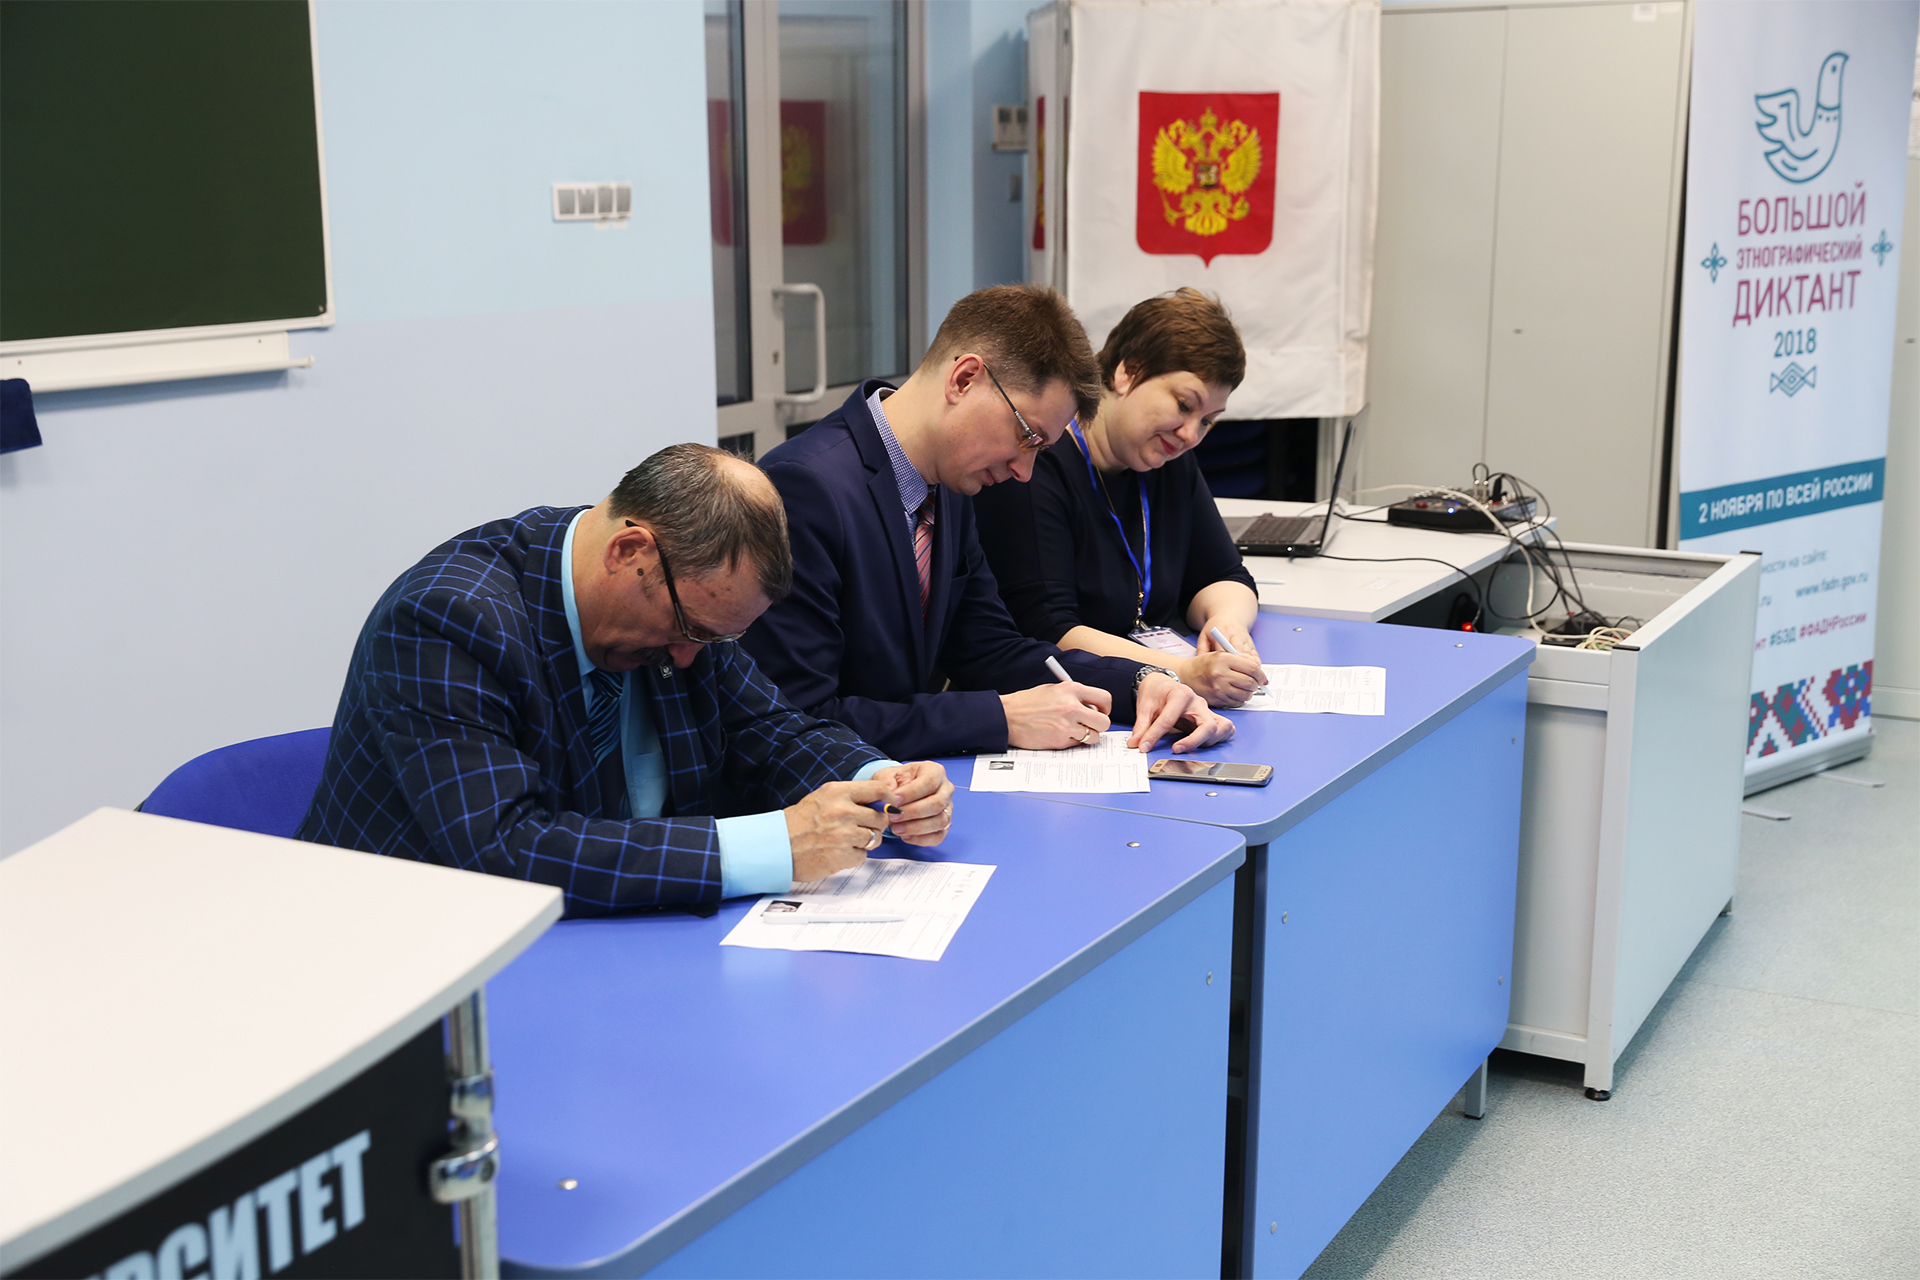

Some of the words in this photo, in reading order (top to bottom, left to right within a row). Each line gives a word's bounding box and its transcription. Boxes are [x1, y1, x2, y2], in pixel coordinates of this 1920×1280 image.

[1738, 181, 1866, 236] БОЛЬШОЙ
[1737, 234, 1863, 270] ЭТНОГРАФИЧЕСКИЙ
[1732, 269, 1862, 328] ДИКТАНТ
[1774, 328, 1817, 358] 2018
[1698, 502, 1708, 524] 2
[1710, 492, 1764, 522] НОЯБРЯ
[1766, 488, 1785, 510] ПО
[1785, 477, 1821, 506] ВСЕЙ
[1823, 471, 1874, 499] РОССИИ
